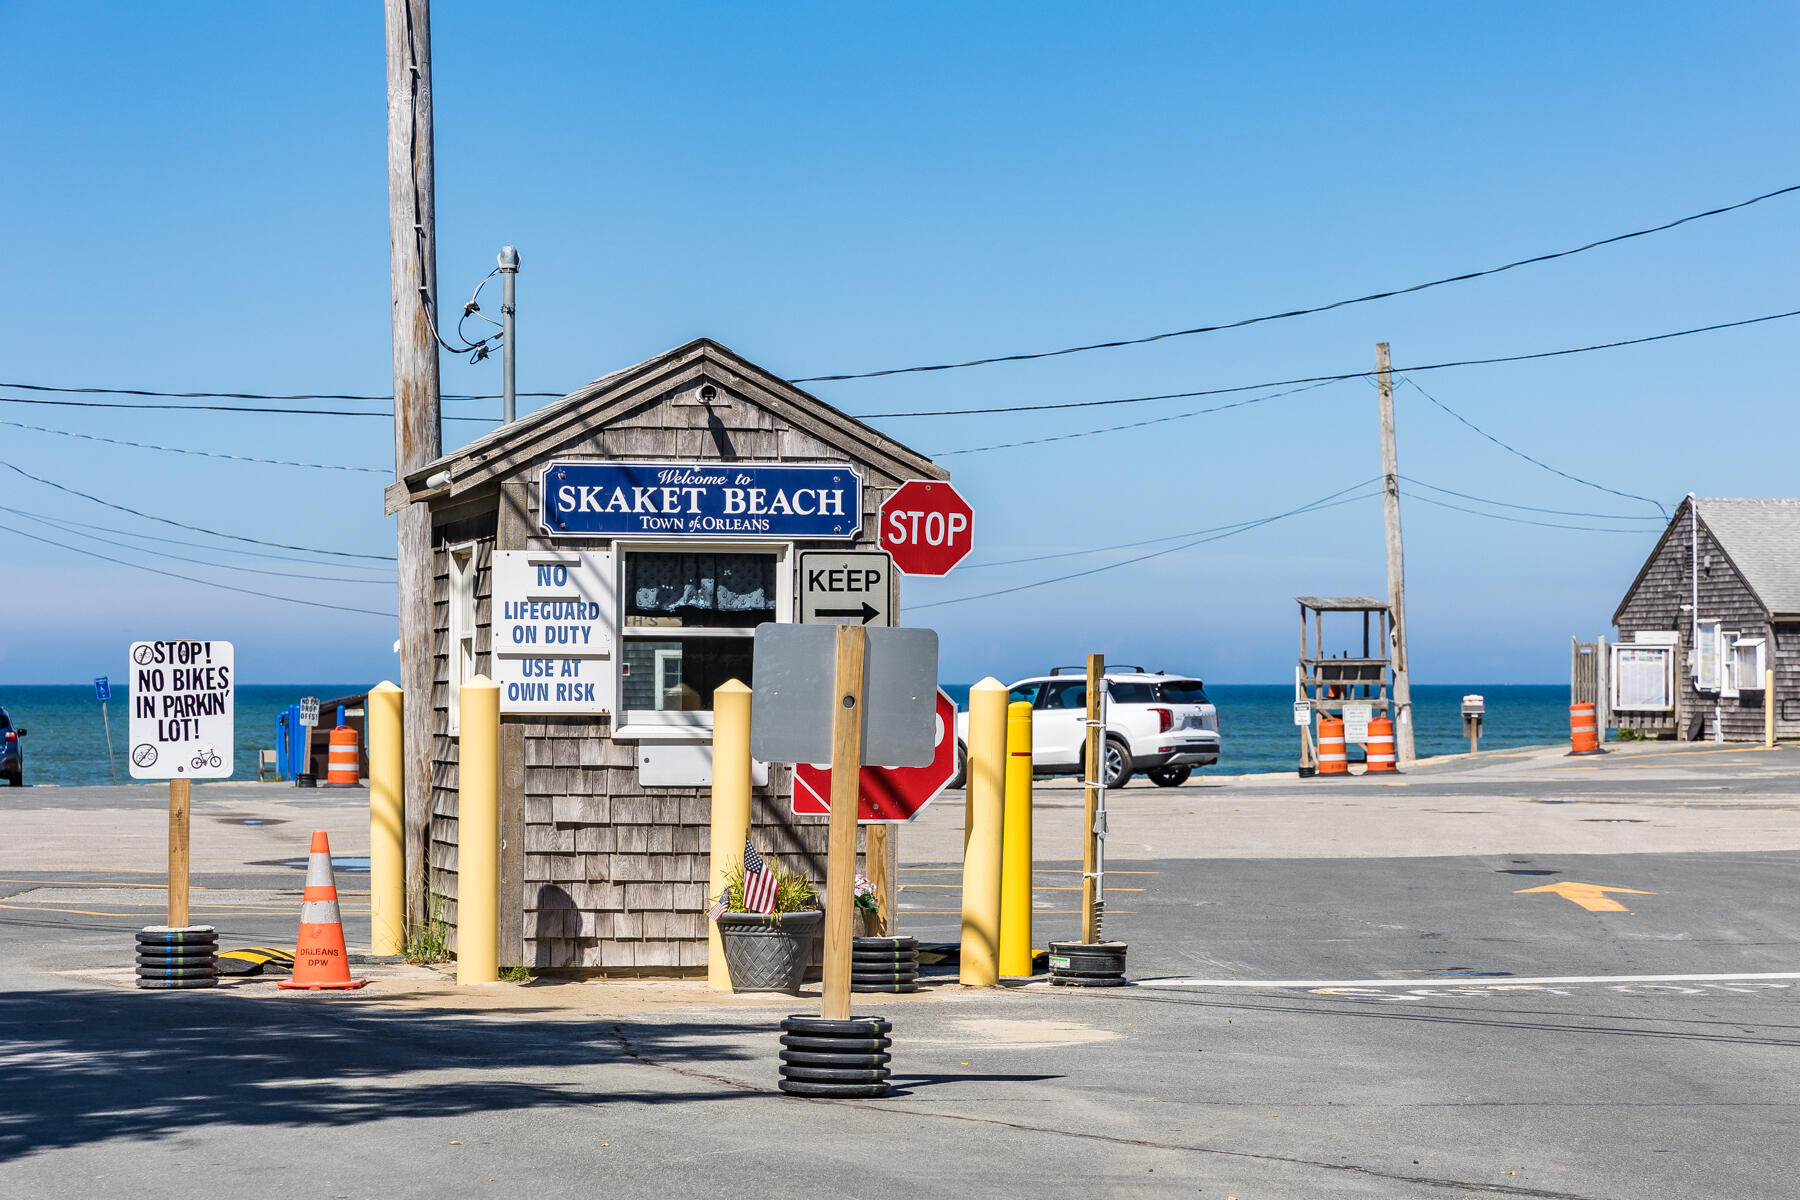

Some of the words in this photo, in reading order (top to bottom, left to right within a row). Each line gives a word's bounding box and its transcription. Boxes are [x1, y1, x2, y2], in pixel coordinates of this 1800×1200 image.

[657, 469, 729, 485] Welcome
[735, 472, 753, 485] to
[557, 485, 707, 514] SKAKET
[723, 487, 846, 516] BEACH
[640, 516, 685, 530] TOWN
[689, 515, 701, 531] of
[702, 516, 770, 531] ORLEANS
[888, 509, 968, 547] STOP
[537, 564, 568, 587] NO
[808, 569, 881, 592] KEEP
[504, 601, 600, 620] LIFEGUARD
[512, 625, 537, 644] ON
[545, 625, 592, 645] DUTY
[153, 641, 212, 665] STOP!
[138, 668, 164, 692] NO
[173, 666, 230, 691] BIKES
[522, 658, 554, 678] USE
[560, 658, 582, 678] AT
[507, 682, 549, 702] OWN
[556, 682, 596, 702] RISK
[136, 695, 156, 719] IN
[162, 689, 231, 718] PARKIN'
[158, 718, 200, 742] LOT!
[300, 948, 339, 956] ORLEANS
